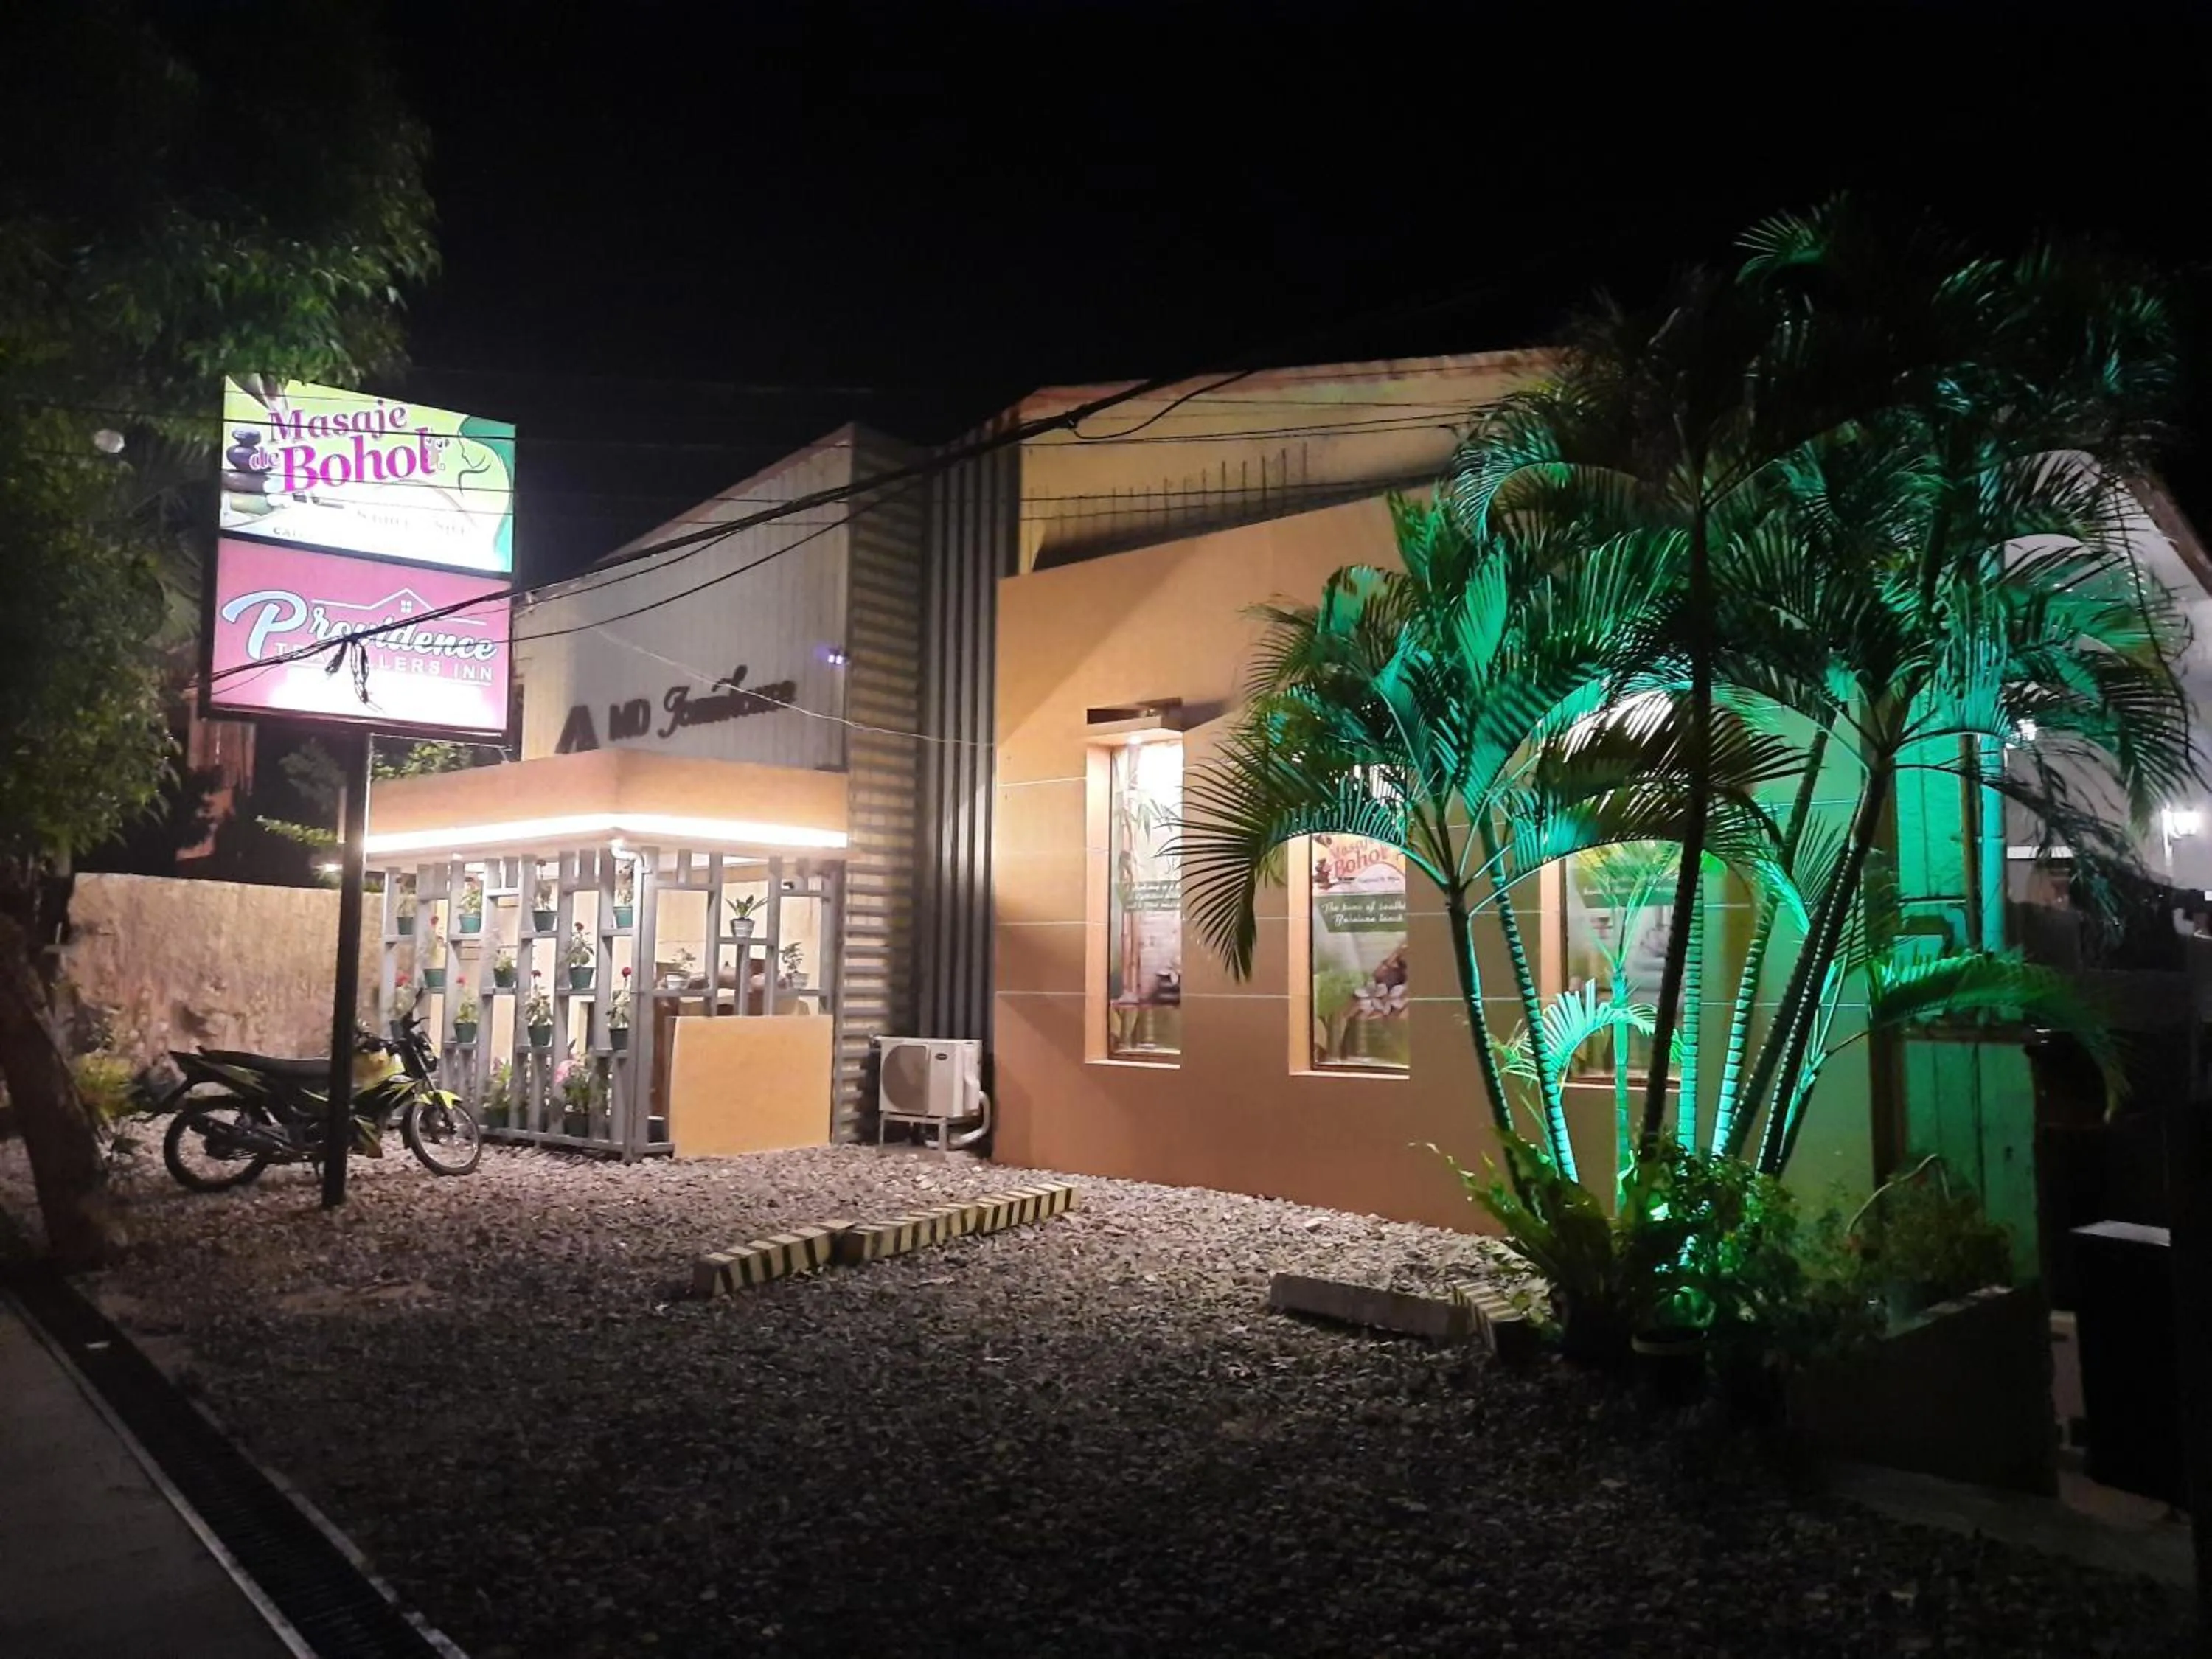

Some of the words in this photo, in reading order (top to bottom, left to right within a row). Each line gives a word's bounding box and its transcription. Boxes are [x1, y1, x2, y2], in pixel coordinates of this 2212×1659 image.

[268, 399, 408, 443] Masaje
[249, 447, 279, 470] de
[279, 427, 437, 493] Bohol
[274, 641, 441, 675] TLERS
[454, 664, 493, 681] INN
